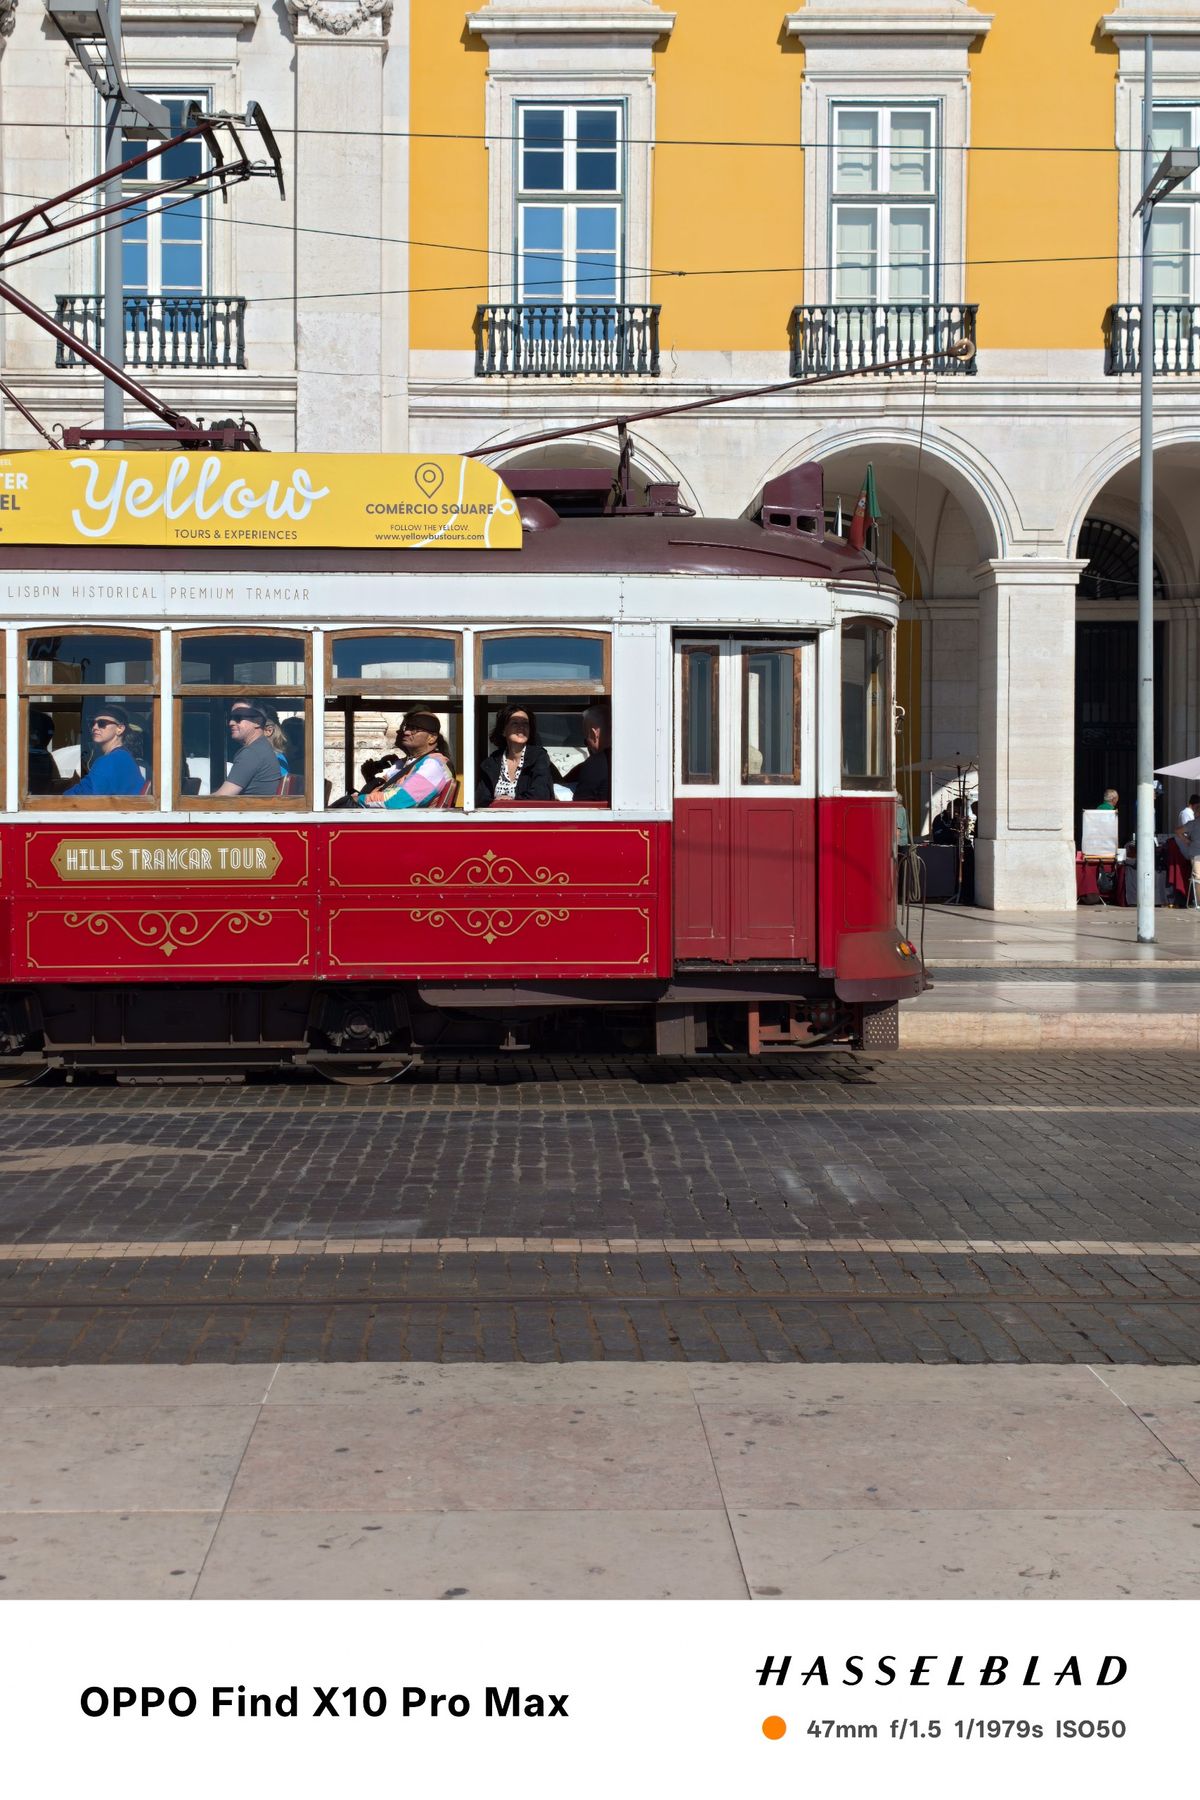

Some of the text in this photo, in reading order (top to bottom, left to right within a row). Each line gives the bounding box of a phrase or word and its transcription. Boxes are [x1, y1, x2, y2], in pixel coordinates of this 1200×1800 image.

[70, 456, 330, 537] Yellow
[366, 501, 494, 515] COMÉRCIO SQUARE
[174, 529, 298, 540] TOURS & EXPERIENCES
[375, 532, 485, 541] www.yellowbustours.com
[7, 586, 311, 601] LISBON HISTORICAL PREMIUM TRAMCAR
[66, 847, 268, 871] HILLS TRAMCAR TOUR
